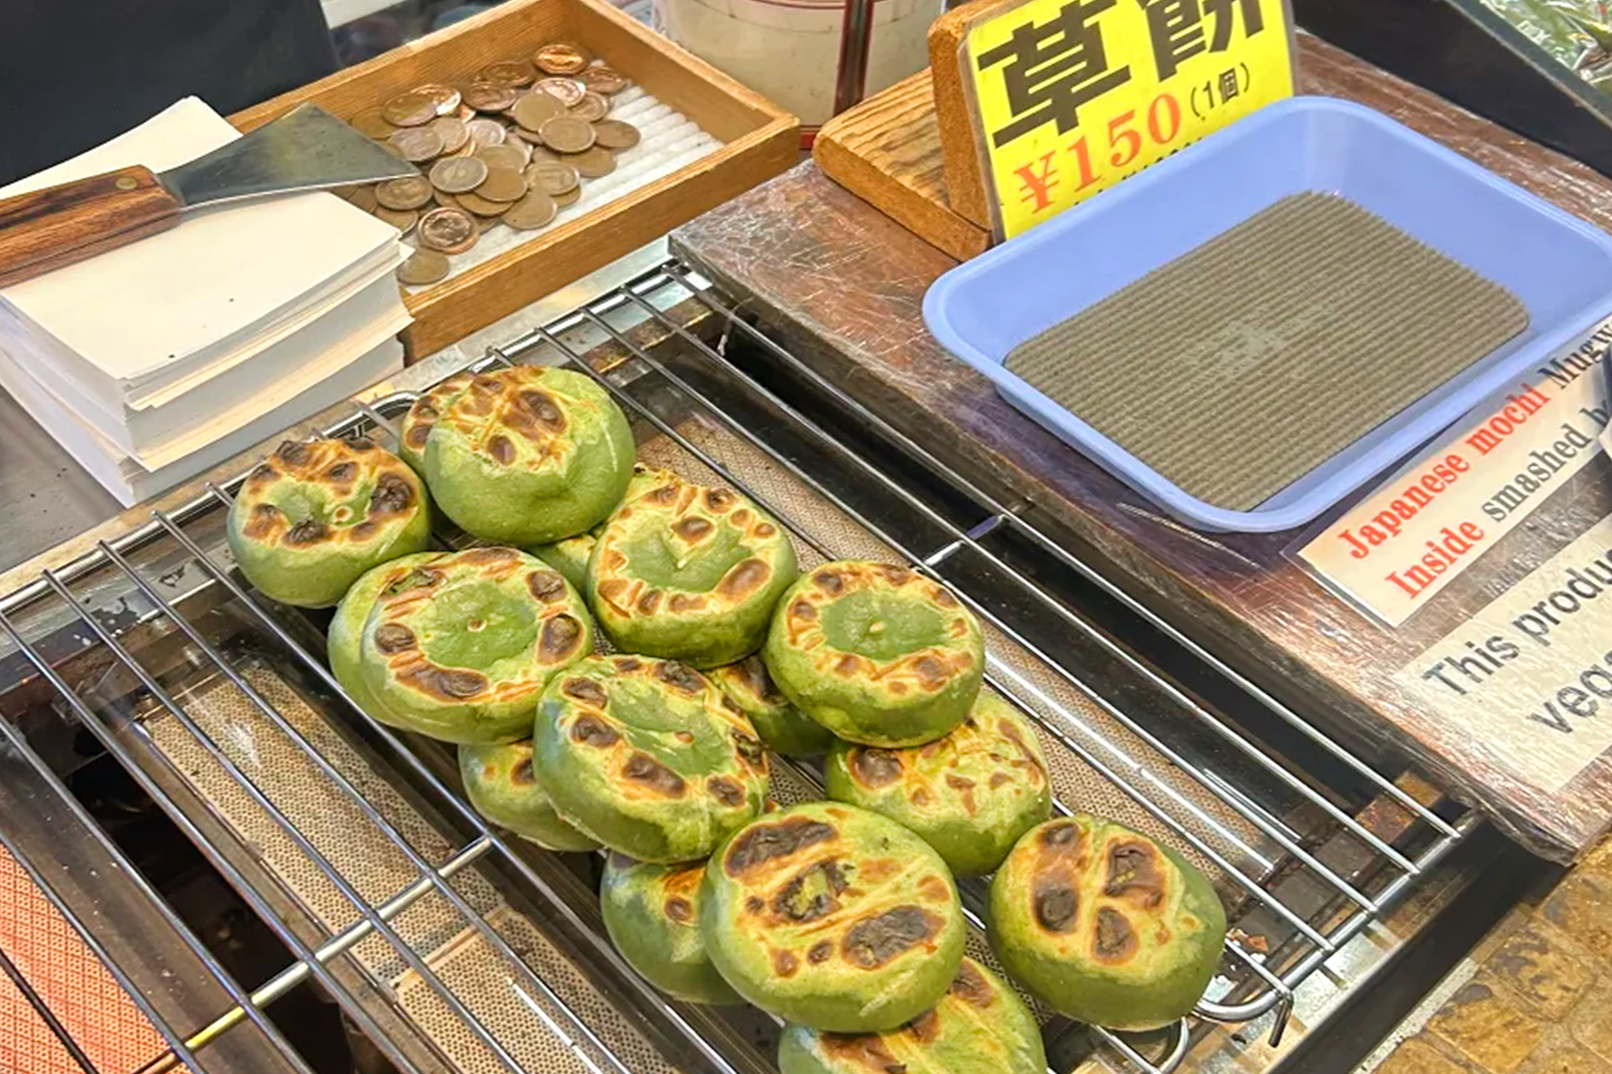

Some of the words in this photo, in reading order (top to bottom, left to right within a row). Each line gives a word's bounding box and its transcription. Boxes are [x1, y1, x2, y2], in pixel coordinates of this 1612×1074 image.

[1014, 93, 1182, 214] ¥150
[1337, 453, 1471, 560] Japanese
[1466, 382, 1551, 456] mochi
[1384, 521, 1486, 600] Inside
[1481, 423, 1593, 523] smashed
[1420, 635, 1520, 696] This
